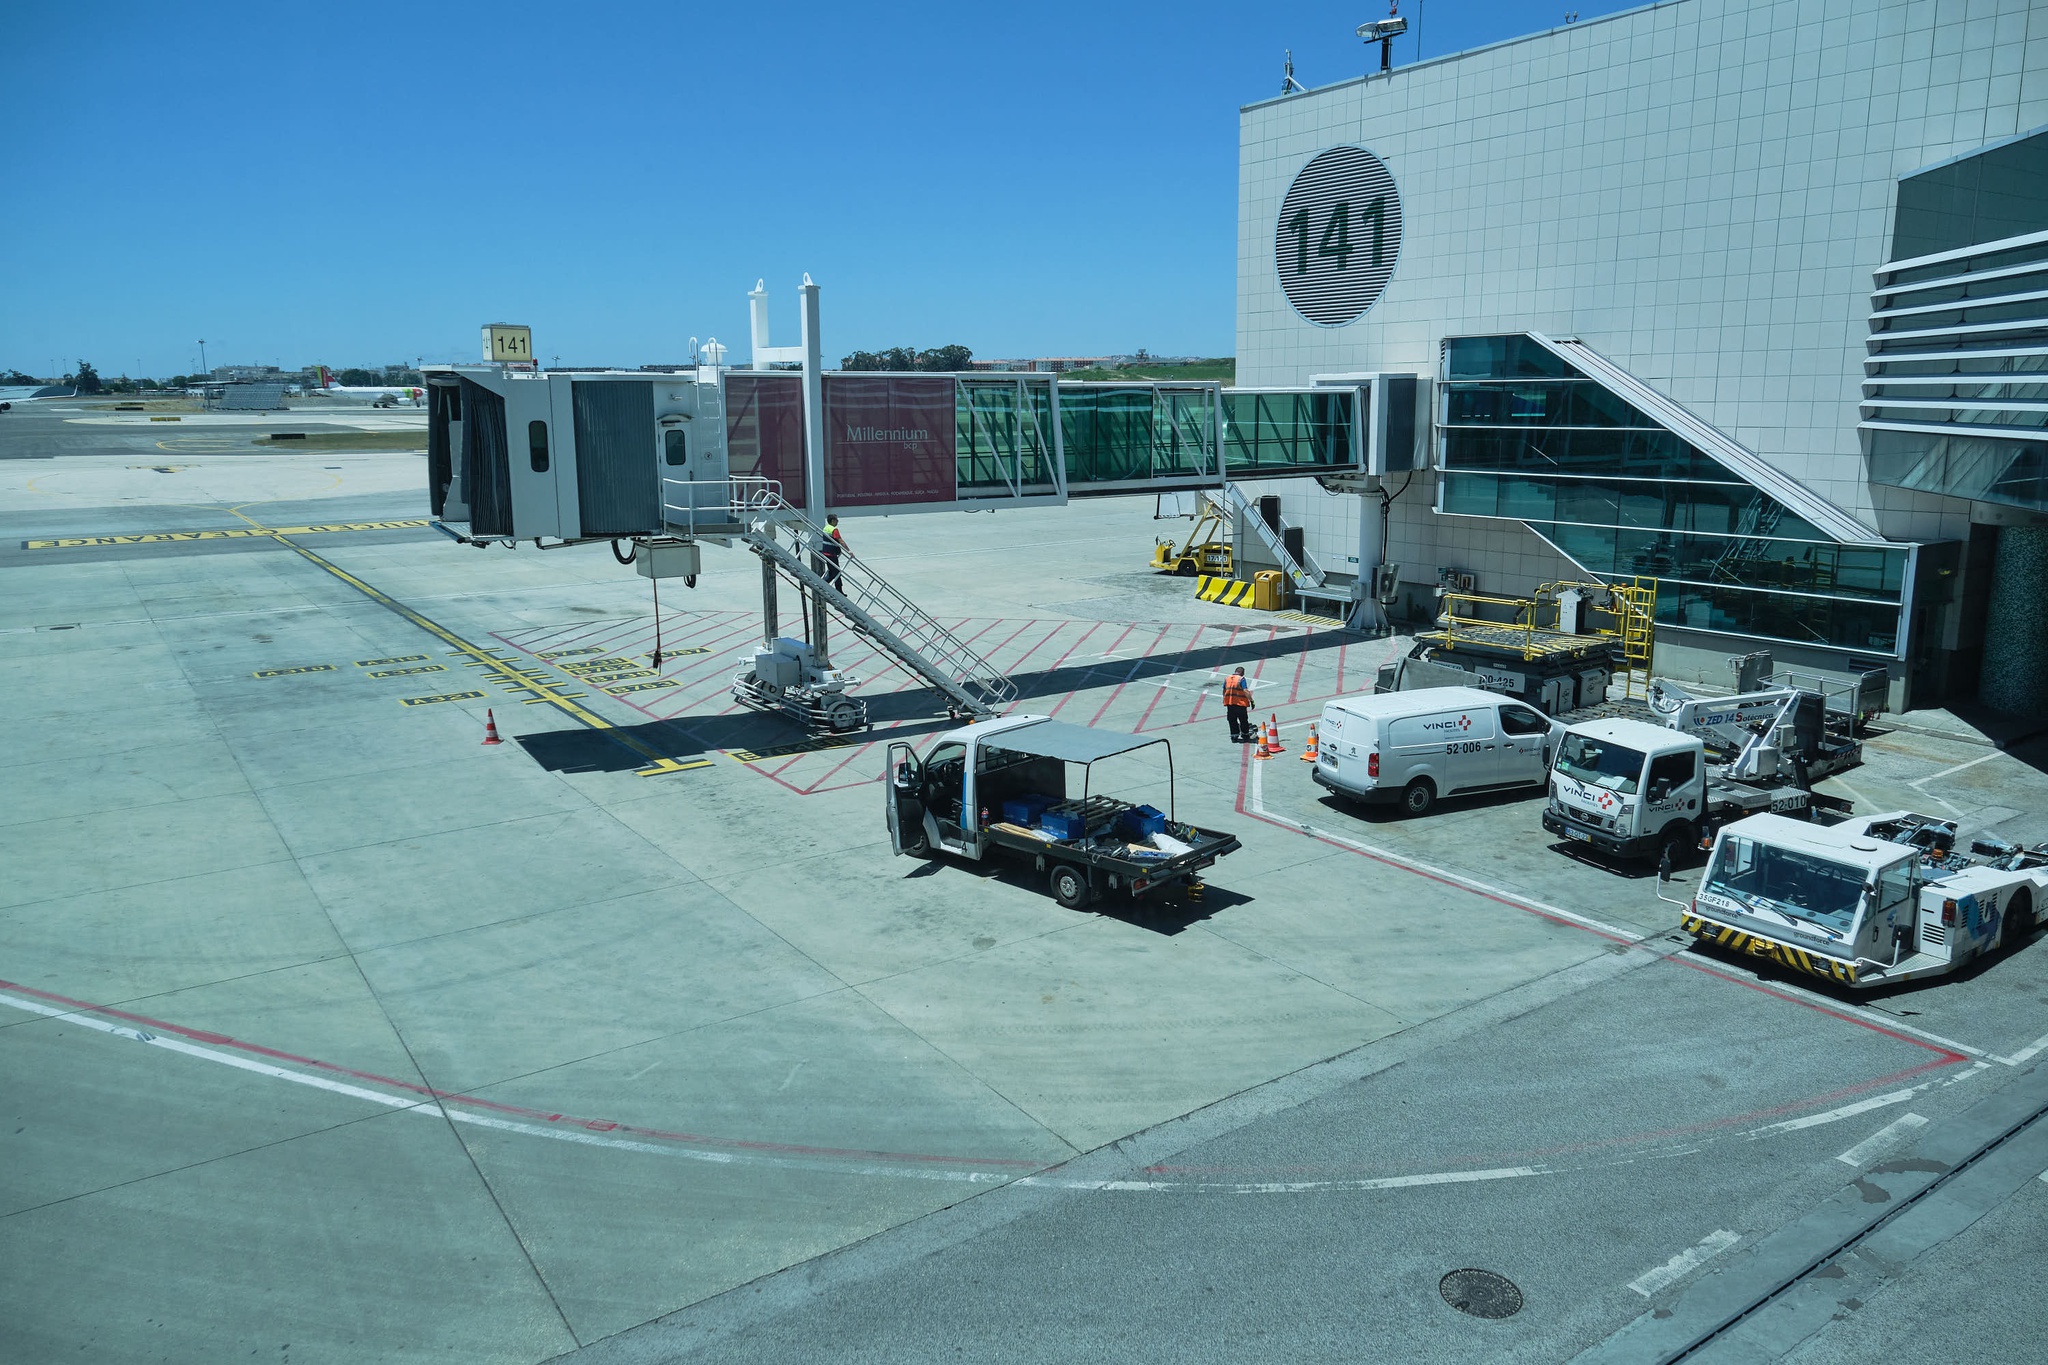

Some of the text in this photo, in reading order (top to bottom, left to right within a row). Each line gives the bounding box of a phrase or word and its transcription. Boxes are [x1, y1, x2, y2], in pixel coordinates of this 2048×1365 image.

[1287, 196, 1385, 275] 141
[497, 336, 526, 354] 141
[846, 423, 928, 442] Millennium
[903, 442, 918, 451] bcp
[39, 528, 278, 549] CLEARANCE
[377, 665, 439, 678] A320
[413, 691, 477, 706] A321
[1423, 721, 1456, 730] VINCI
[1706, 714, 1723, 726] ZED
[1725, 713, 1735, 723] 14
[1446, 741, 1481, 755] 52-006
[1563, 785, 1595, 801] VINCI
[1648, 803, 1674, 812] VINCI
[1772, 796, 1806, 812] 52-010
[961, 842, 968, 853] 4
[1705, 904, 1739, 919] groundforce
[1794, 931, 1830, 946] groundforce
